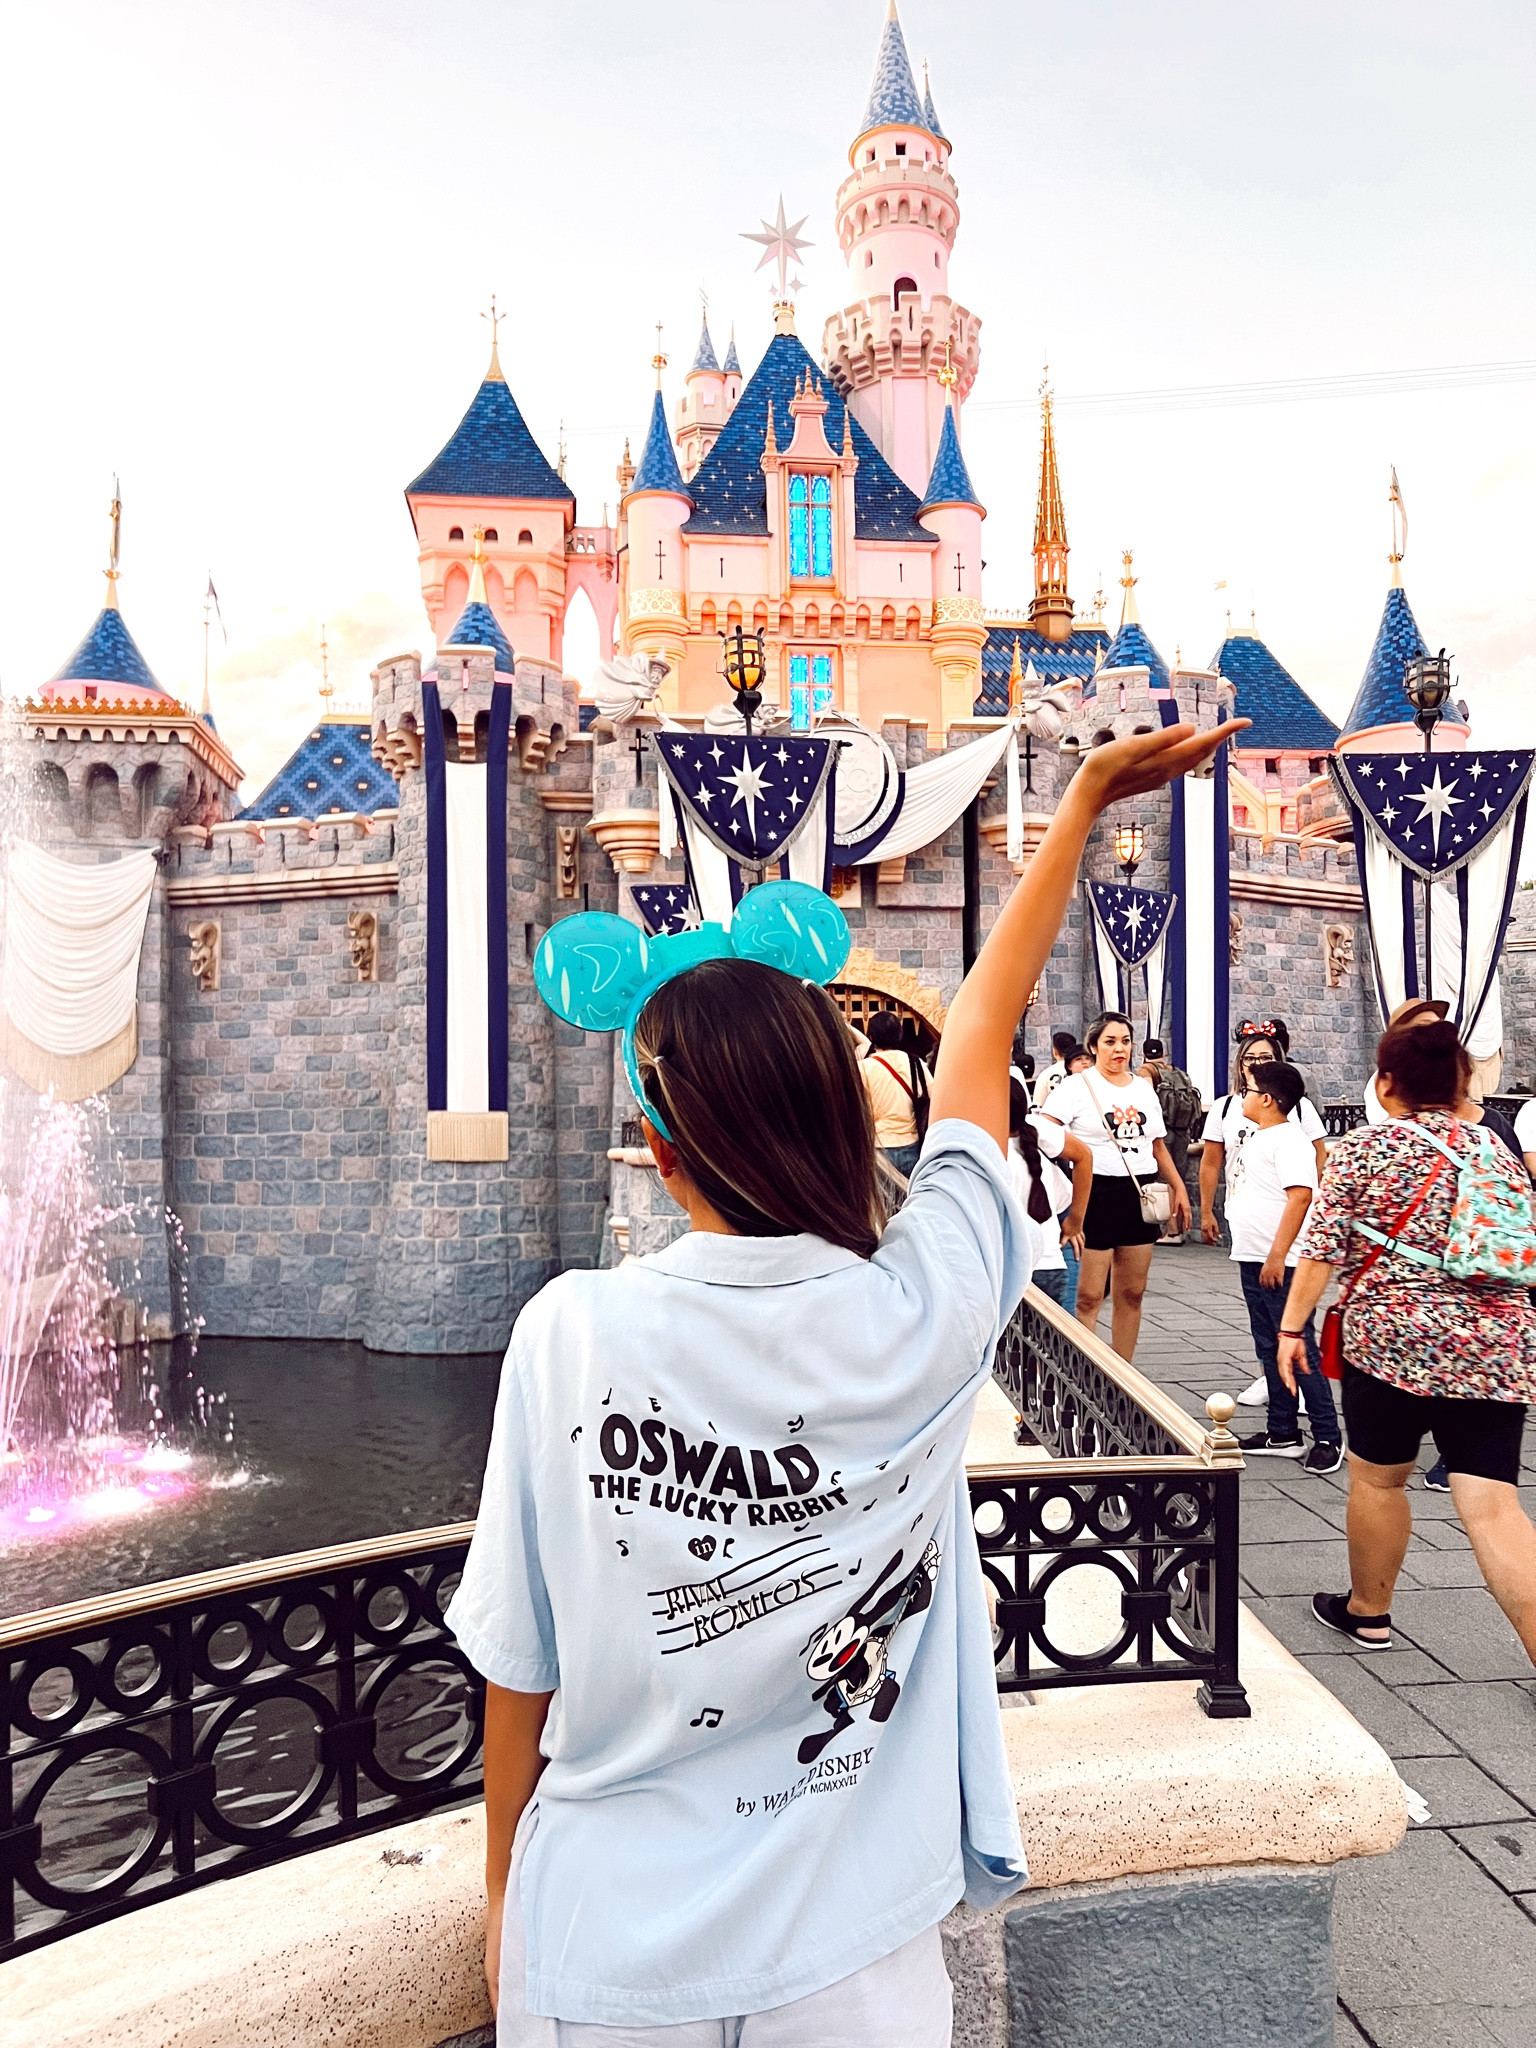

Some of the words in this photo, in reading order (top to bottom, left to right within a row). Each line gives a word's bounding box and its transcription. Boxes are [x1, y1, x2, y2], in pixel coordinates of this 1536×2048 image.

[600, 1413, 820, 1500] OSWALD
[589, 1474, 642, 1502] THE
[649, 1482, 739, 1525] LUCKY
[747, 1486, 849, 1527] RABBIT
[694, 1539, 714, 1557] in
[665, 1577, 735, 1620] RIVAL
[693, 1569, 815, 1648] ROMEOS
[736, 1796, 756, 1817] by
[807, 1747, 875, 1784] DISNEY
[810, 1774, 858, 1795] MCMXXVII
